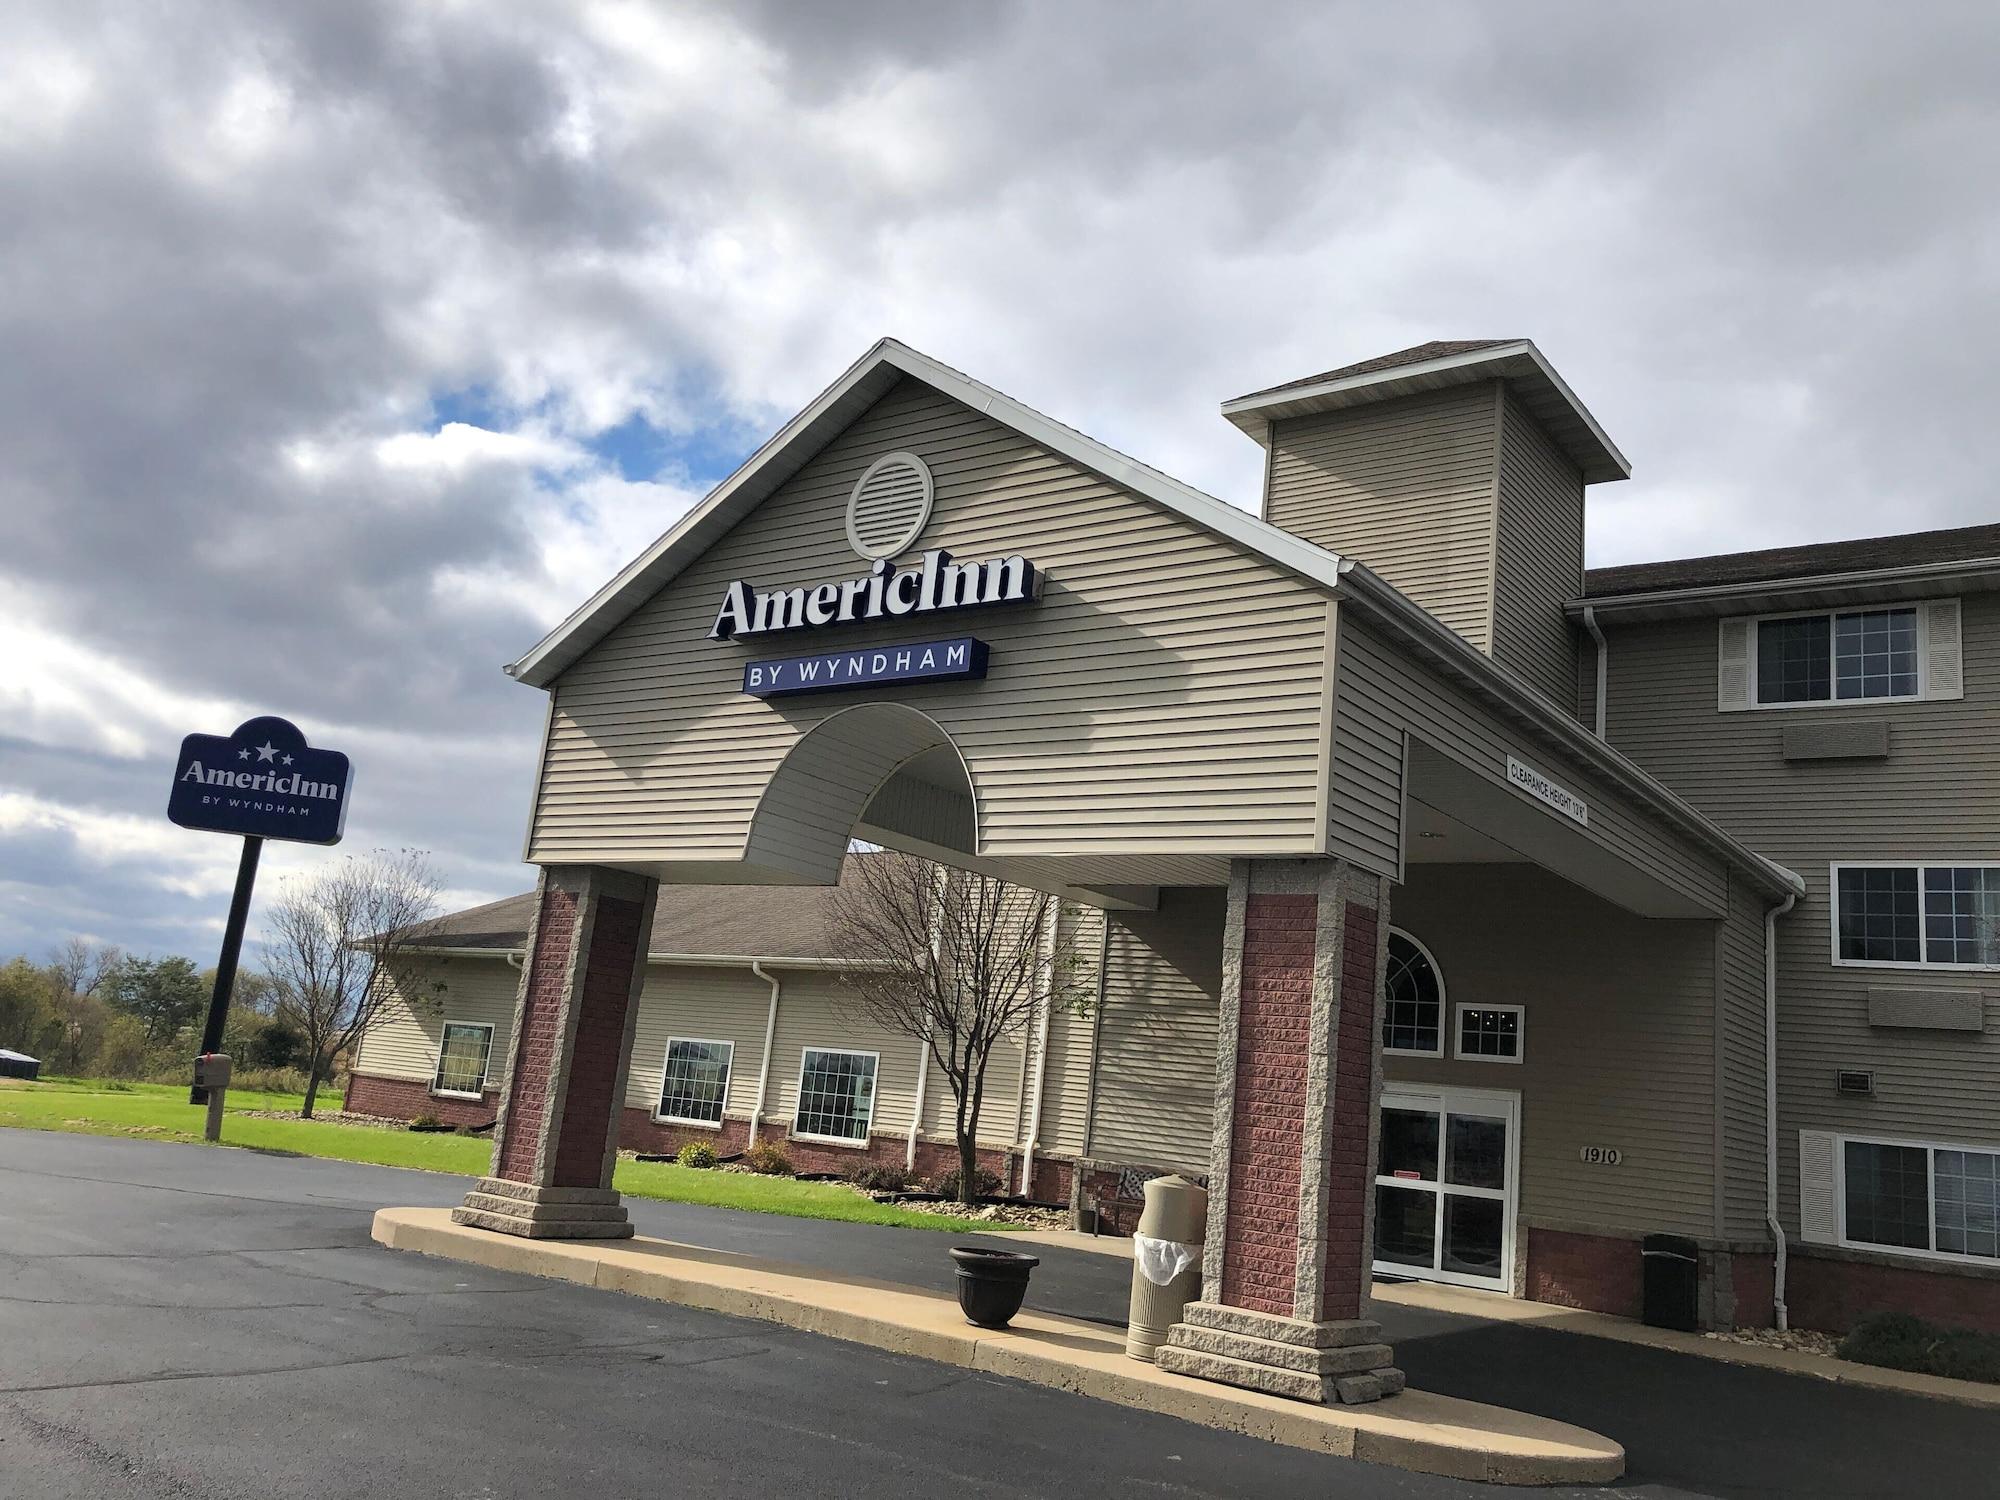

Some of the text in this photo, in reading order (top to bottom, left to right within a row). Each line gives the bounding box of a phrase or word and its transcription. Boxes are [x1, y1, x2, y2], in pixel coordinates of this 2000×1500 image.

[706, 549, 1030, 640] AmericInn
[749, 644, 966, 688] BY WYNDHAM
[180, 760, 339, 801] AmericInn
[1511, 763, 1548, 798] CLEARANCE
[1549, 786, 1572, 811] HEIGHT
[202, 795, 310, 816] BY WYNDHAM
[1585, 1147, 1617, 1164] 1910
